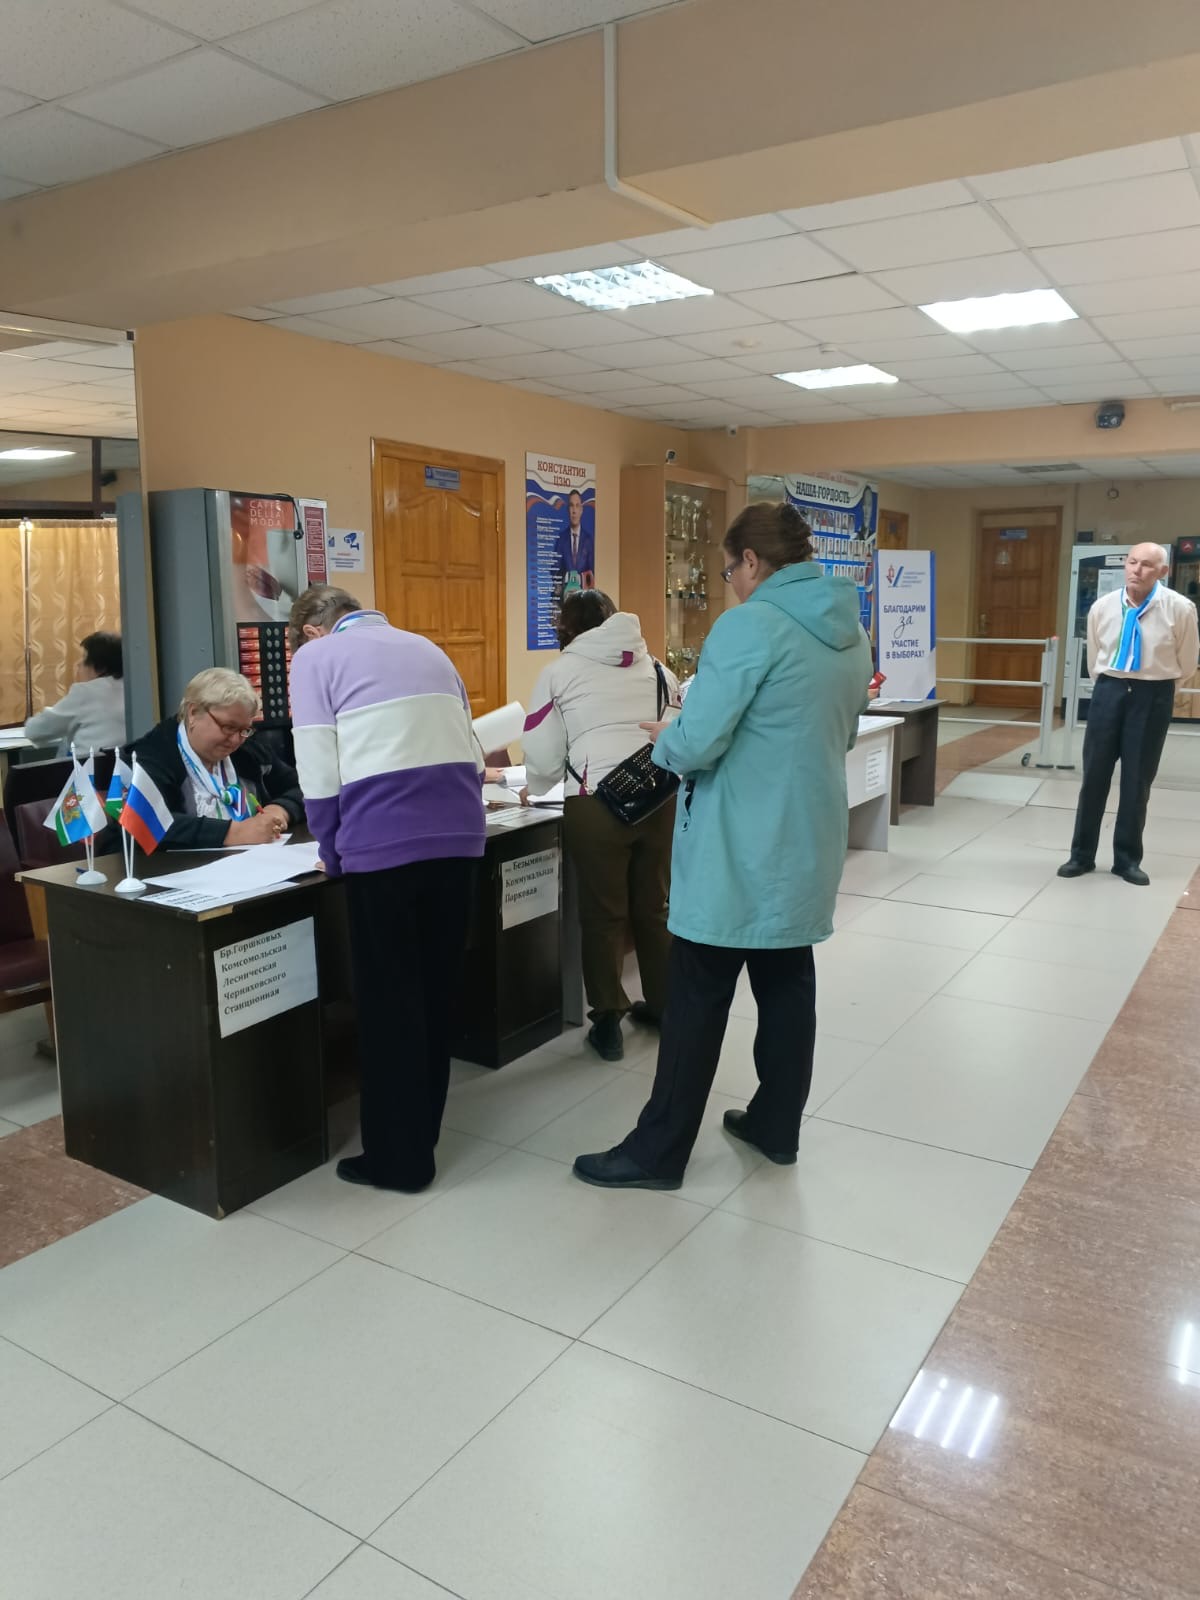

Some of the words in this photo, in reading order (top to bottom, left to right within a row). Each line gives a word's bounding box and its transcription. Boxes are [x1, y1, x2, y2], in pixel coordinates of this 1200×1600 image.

[537, 460, 586, 478] КОНСТАНТИН
[553, 475, 571, 488] ЦЗЮ
[796, 481, 817, 498] НАША
[818, 485, 851, 504] ГОРДОСТЬ
[883, 604, 926, 614] БЛАГОДАРИМ
[893, 615, 913, 639] за
[885, 651, 891, 659] В
[892, 650, 925, 659] ВЫБОРАХ!
[891, 639, 919, 649] УЧАСТИЕ
[221, 943, 288, 973] Комсомольская
[223, 961, 278, 988] Лесническая
[223, 971, 287, 1001] Черняховского
[224, 987, 280, 1015] Станционная
